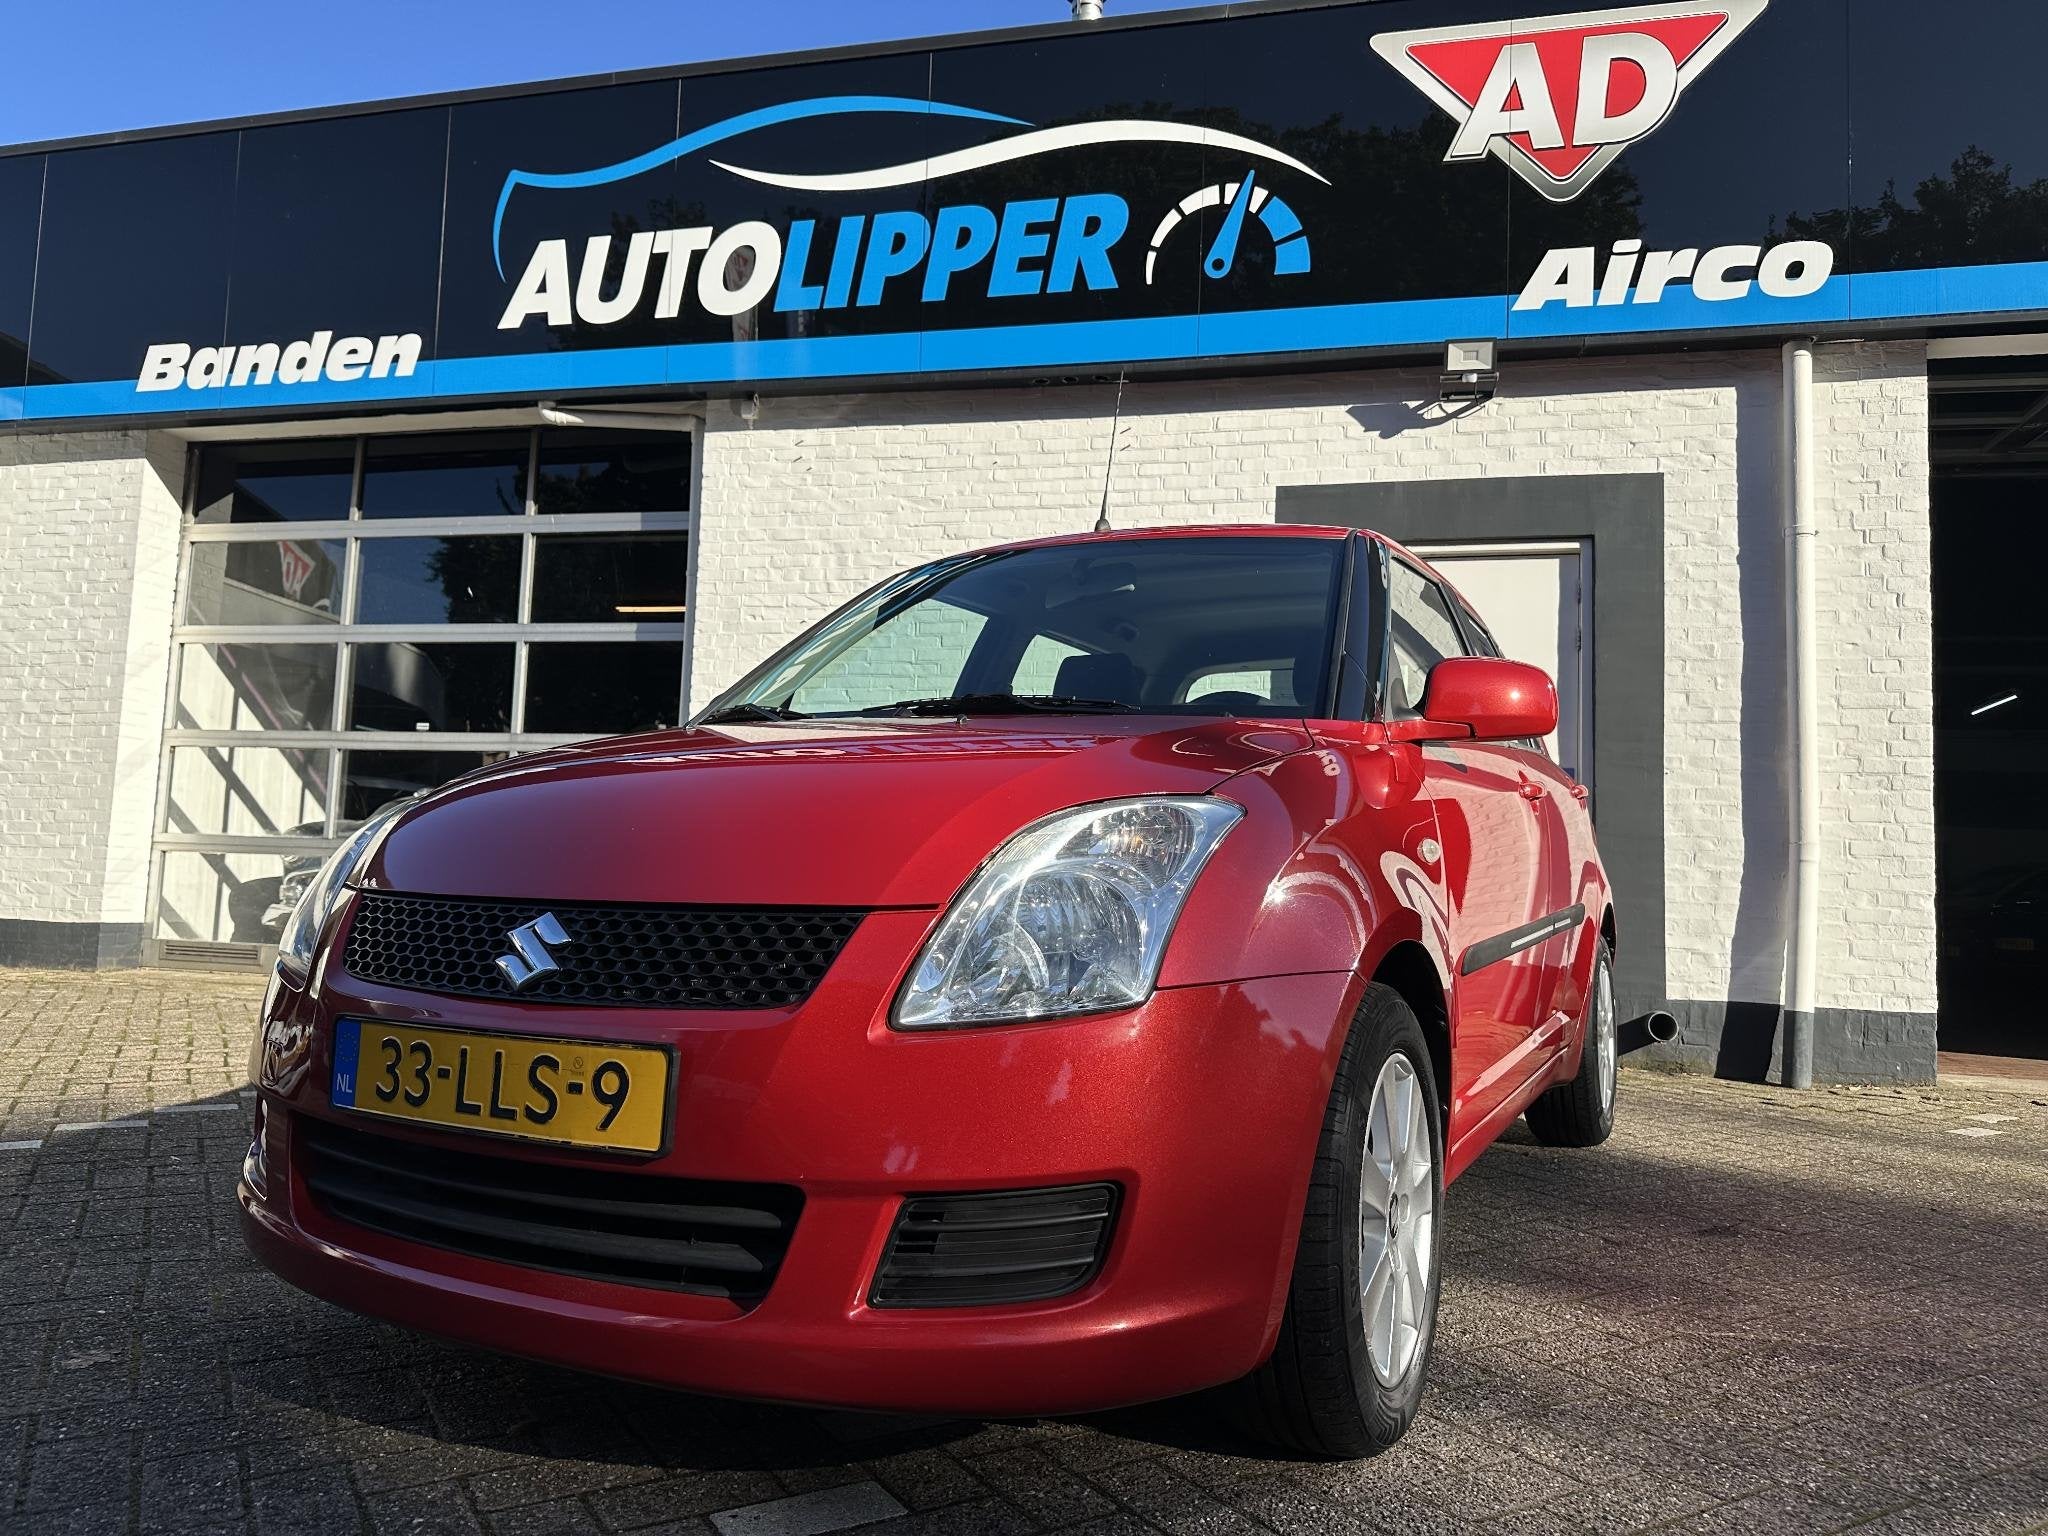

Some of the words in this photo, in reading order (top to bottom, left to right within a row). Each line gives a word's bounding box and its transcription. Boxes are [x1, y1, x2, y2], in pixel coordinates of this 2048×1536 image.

[1449, 31, 1679, 160] AD
[1511, 238, 1834, 311] Airco
[135, 330, 423, 393] Banden
[336, 1072, 353, 1093] NL
[375, 1035, 632, 1132] 33-LLS-9
